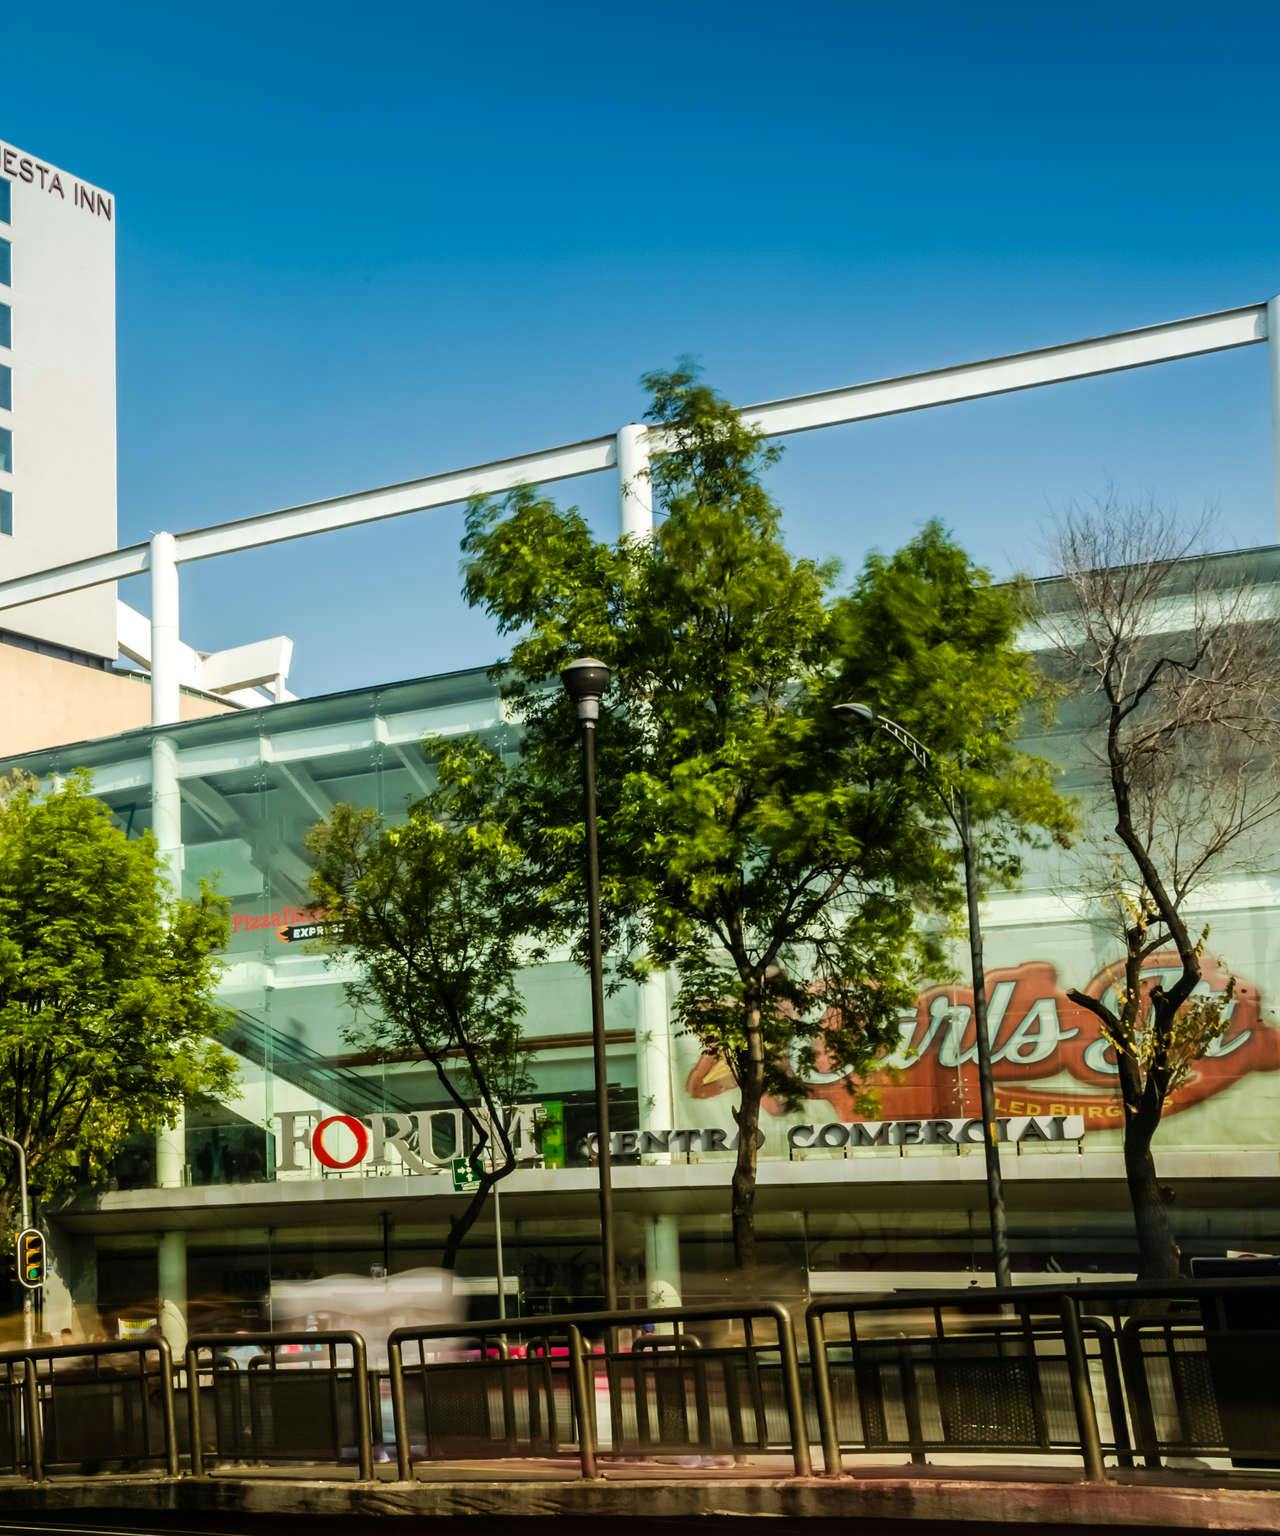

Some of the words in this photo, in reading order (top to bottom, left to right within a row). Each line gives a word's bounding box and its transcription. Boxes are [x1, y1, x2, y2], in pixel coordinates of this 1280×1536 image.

[74, 182, 112, 222] INN
[292, 923, 346, 939] EXPRSS
[1049, 1095, 1174, 1119] BURGS
[273, 1103, 546, 1176] FORUM
[786, 1115, 1083, 1149] COMERCIAL
